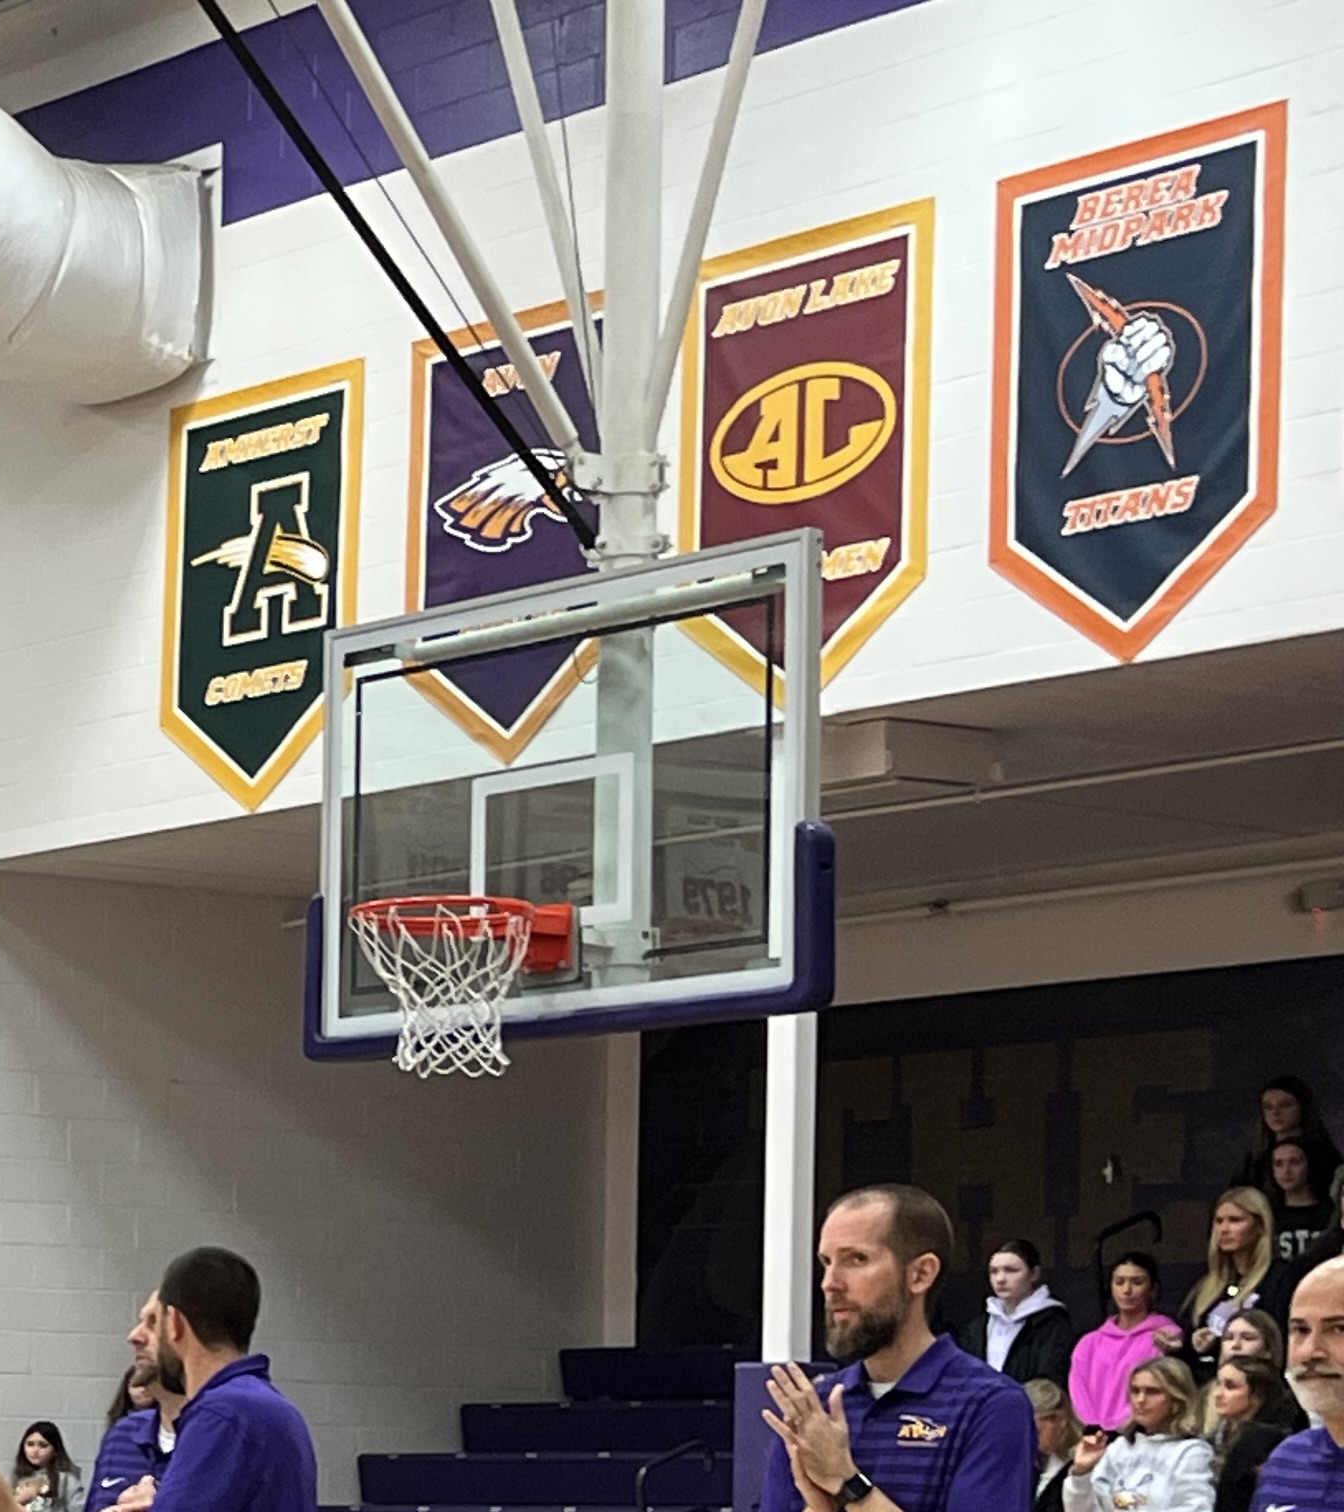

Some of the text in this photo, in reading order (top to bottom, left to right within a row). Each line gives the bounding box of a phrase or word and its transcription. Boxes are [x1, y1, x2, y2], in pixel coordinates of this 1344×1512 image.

[1070, 163, 1202, 230] BEREA
[1044, 189, 1229, 270] MIDPARK
[712, 259, 901, 338] AVON LAKE
[199, 412, 330, 473] AMHERST
[1061, 475, 1200, 536] TITANS
[205, 659, 308, 706] COMETS
